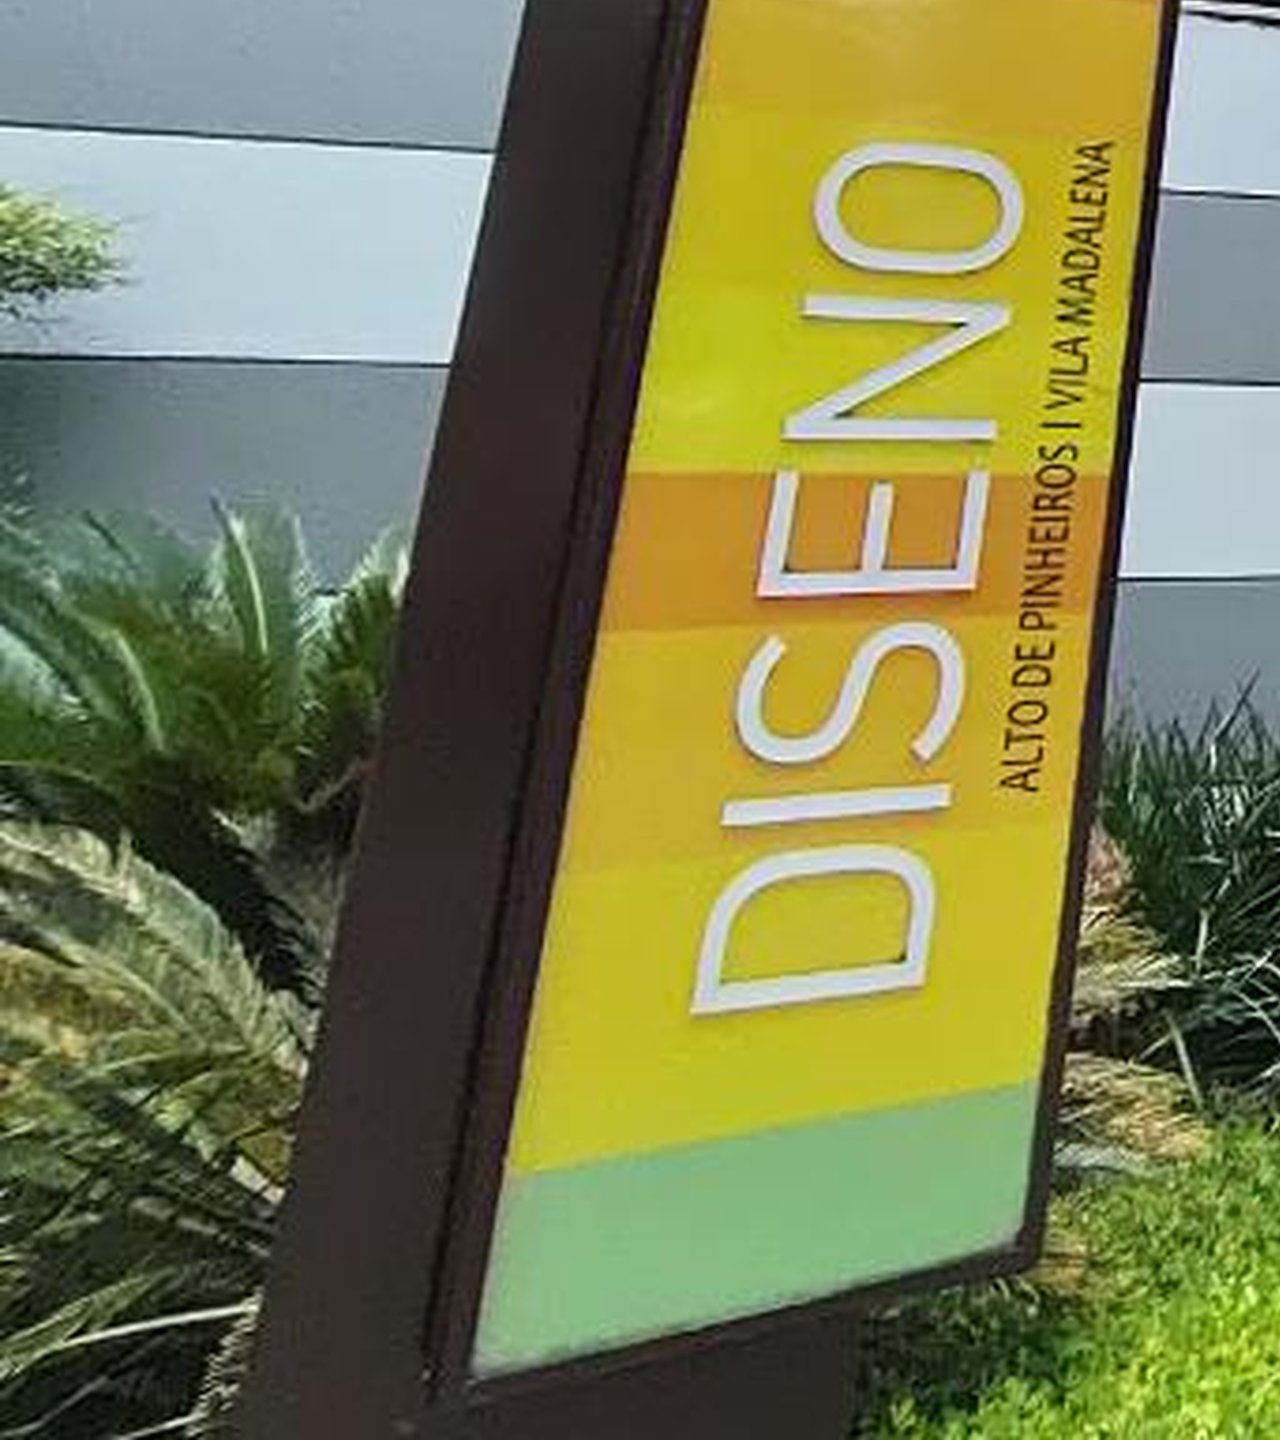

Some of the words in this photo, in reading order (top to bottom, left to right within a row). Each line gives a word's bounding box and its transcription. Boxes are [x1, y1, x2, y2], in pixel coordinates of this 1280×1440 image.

[1054, 139, 1116, 327] MADALENA
[1042, 334, 1090, 411] VILA
[690, 140, 1026, 1015] DISENO
[1018, 443, 1081, 632] PINHEIROS
[1012, 641, 1056, 688] DE
[1000, 699, 1049, 793] ALTO
